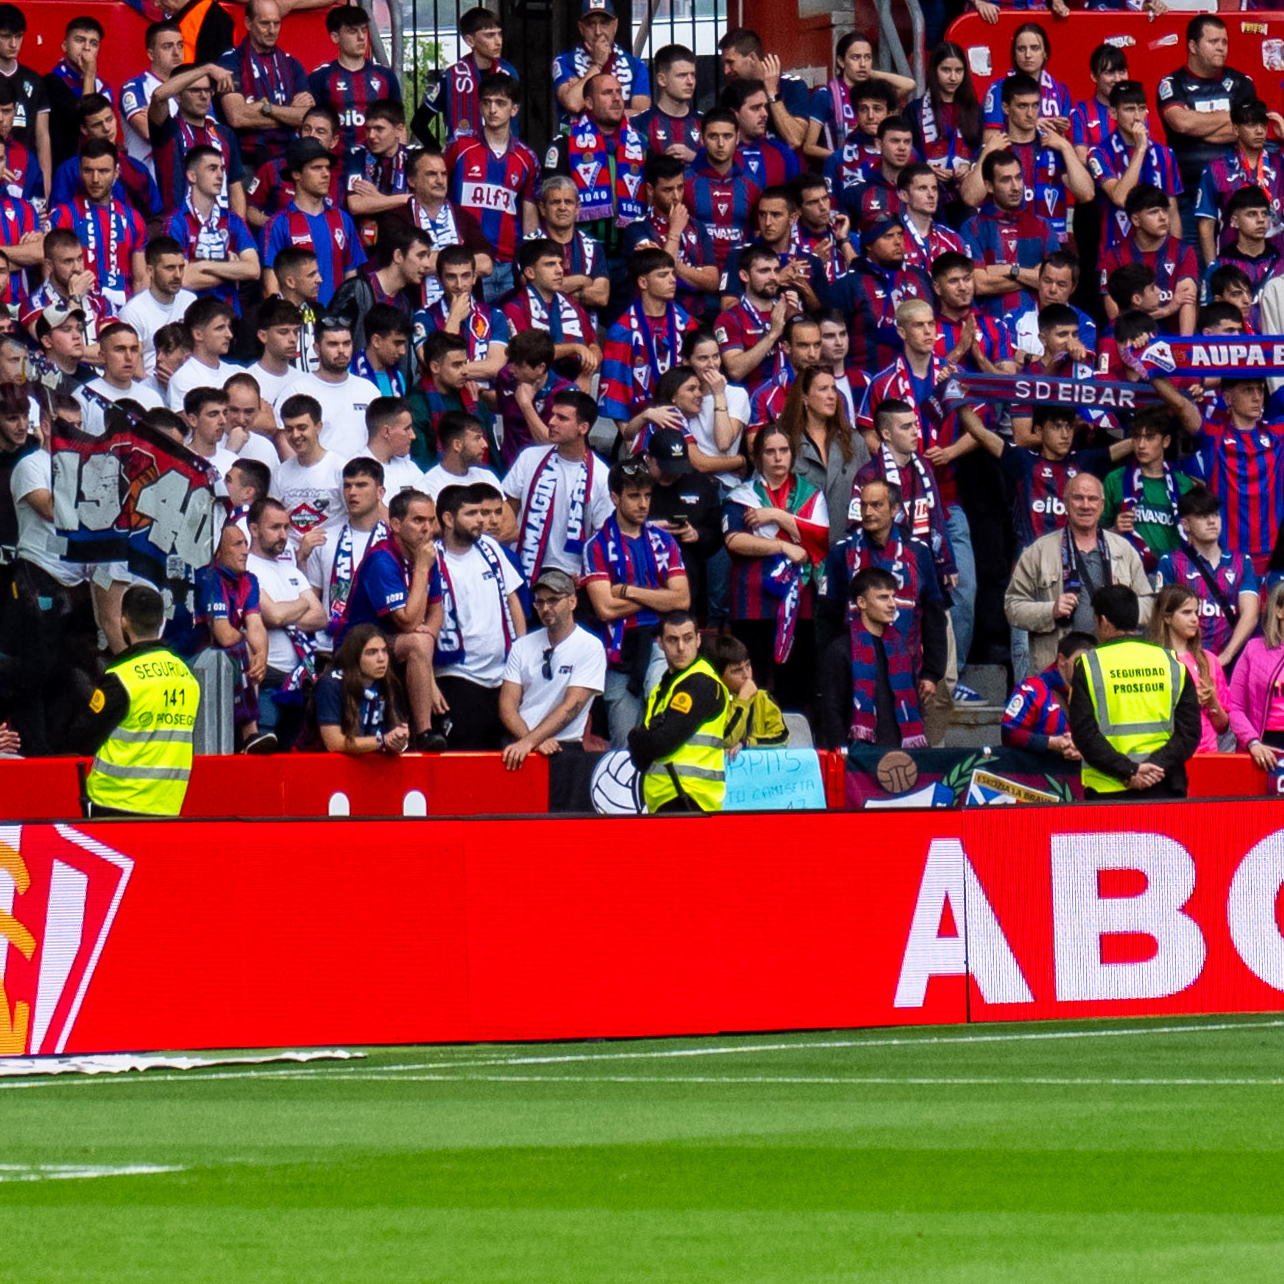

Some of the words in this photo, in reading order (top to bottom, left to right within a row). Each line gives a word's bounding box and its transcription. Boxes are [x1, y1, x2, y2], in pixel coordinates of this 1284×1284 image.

[1191, 345, 1268, 367] AUPA
[1058, 384, 1136, 409] EIBAR
[1109, 667, 1166, 679] SEGURIDAD
[1113, 681, 1165, 693] PROSEGUR
[163, 688, 186, 708] 141
